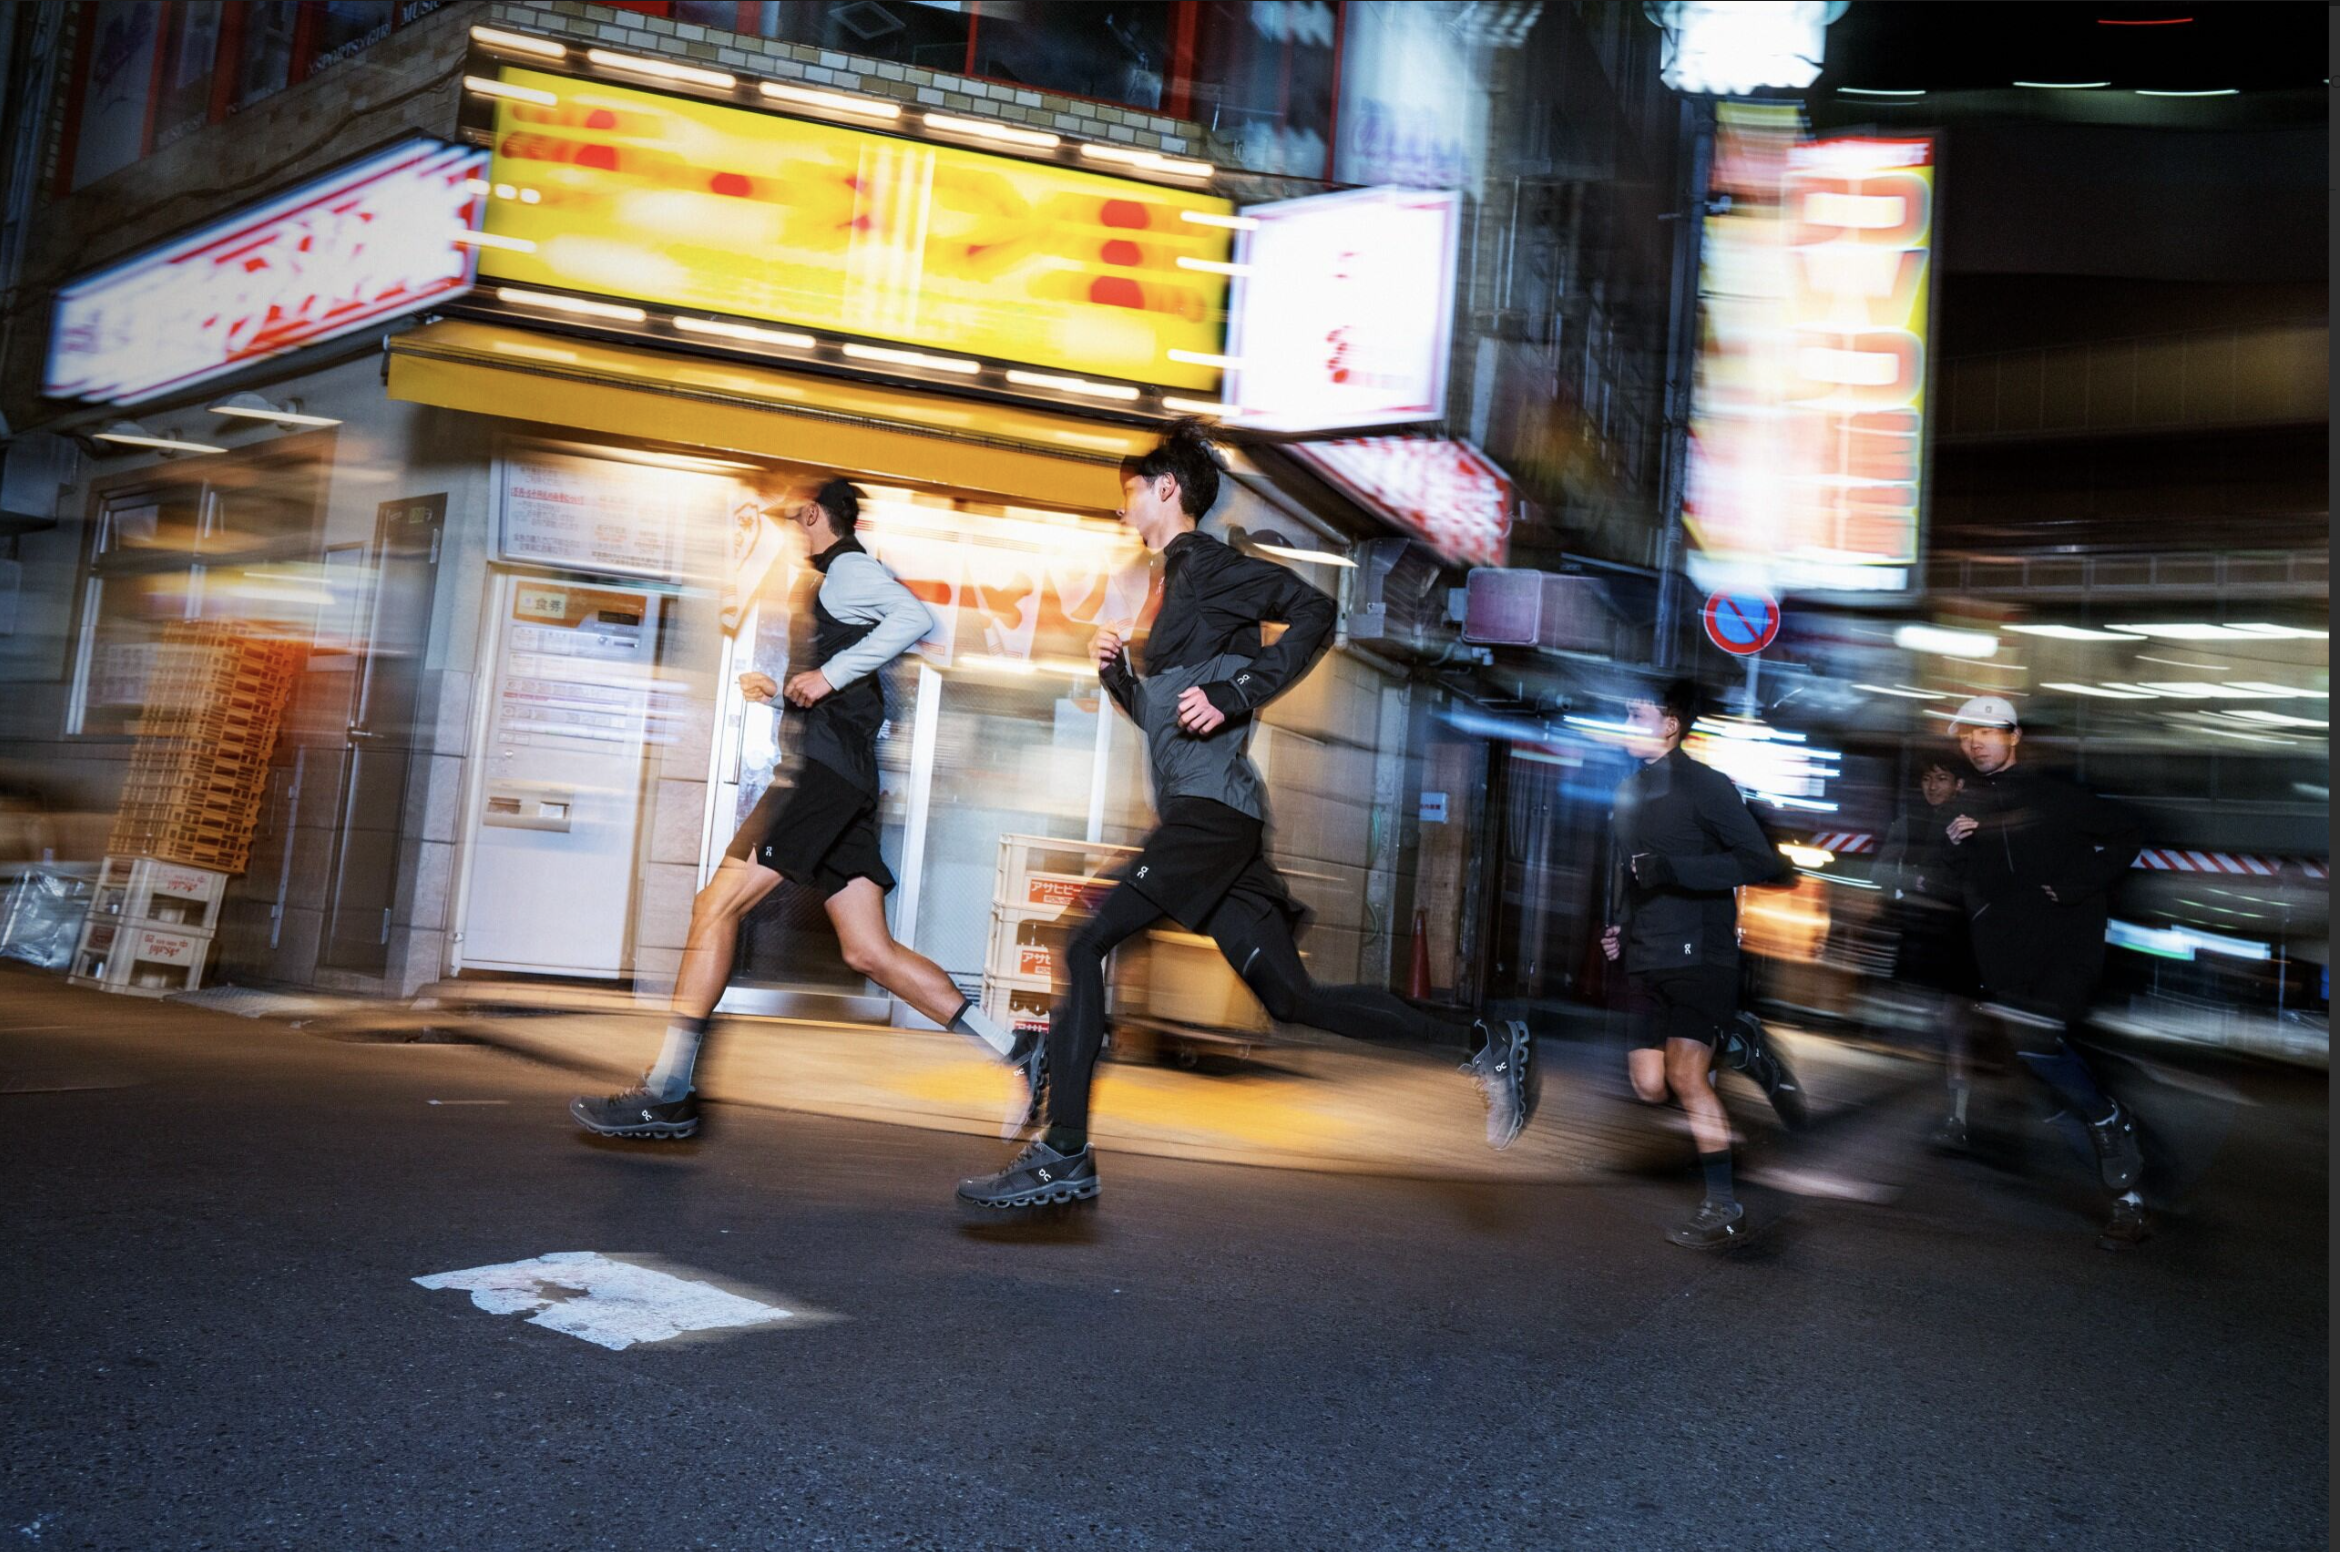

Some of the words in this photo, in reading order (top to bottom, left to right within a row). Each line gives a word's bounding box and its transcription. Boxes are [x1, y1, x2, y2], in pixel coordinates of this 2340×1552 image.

[1031, 881, 1084, 896] アサヒビー
